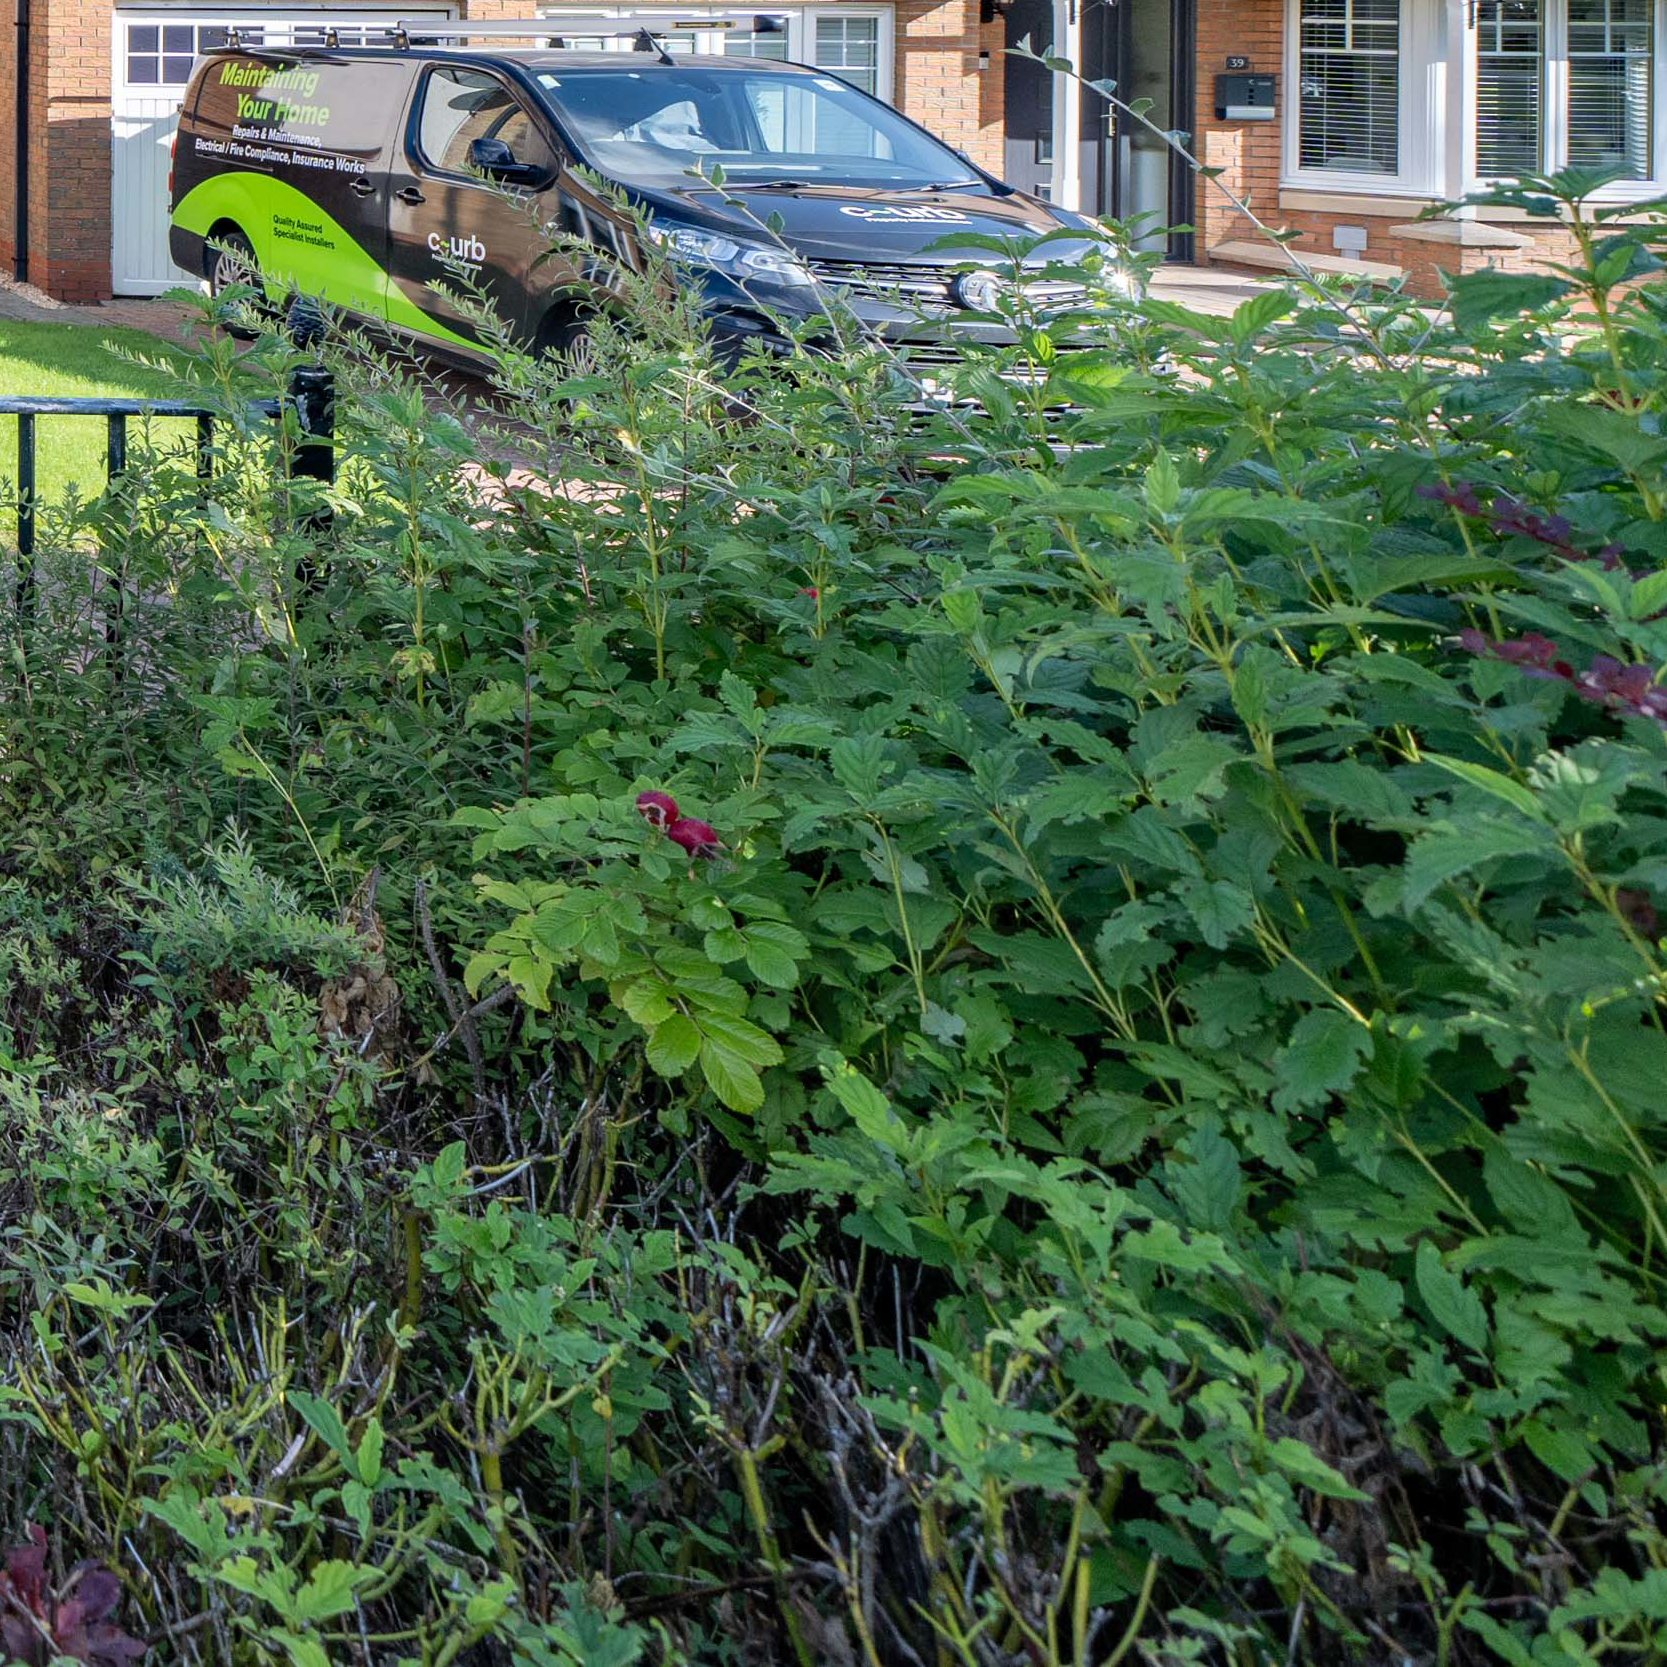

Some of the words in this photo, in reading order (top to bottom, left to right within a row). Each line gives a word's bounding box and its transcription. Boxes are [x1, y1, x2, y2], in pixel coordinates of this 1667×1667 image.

[1229, 58, 1244, 68] 39
[219, 61, 320, 98] Maintaining
[236, 93, 273, 121] Your
[274, 97, 330, 127] Home
[232, 125, 260, 139] Repairs
[260, 127, 268, 140] &
[268, 128, 322, 148] Maintenance,
[195, 138, 225, 153] Electrical
[230, 142, 244, 156] Fire
[245, 145, 291, 165] Compliance,
[292, 151, 335, 170] Insurance
[336, 158, 365, 174] Works
[273, 214, 296, 229] Quality
[296, 220, 323, 234] Assured
[273, 227, 304, 242] Specialist
[305, 234, 335, 250] Installers
